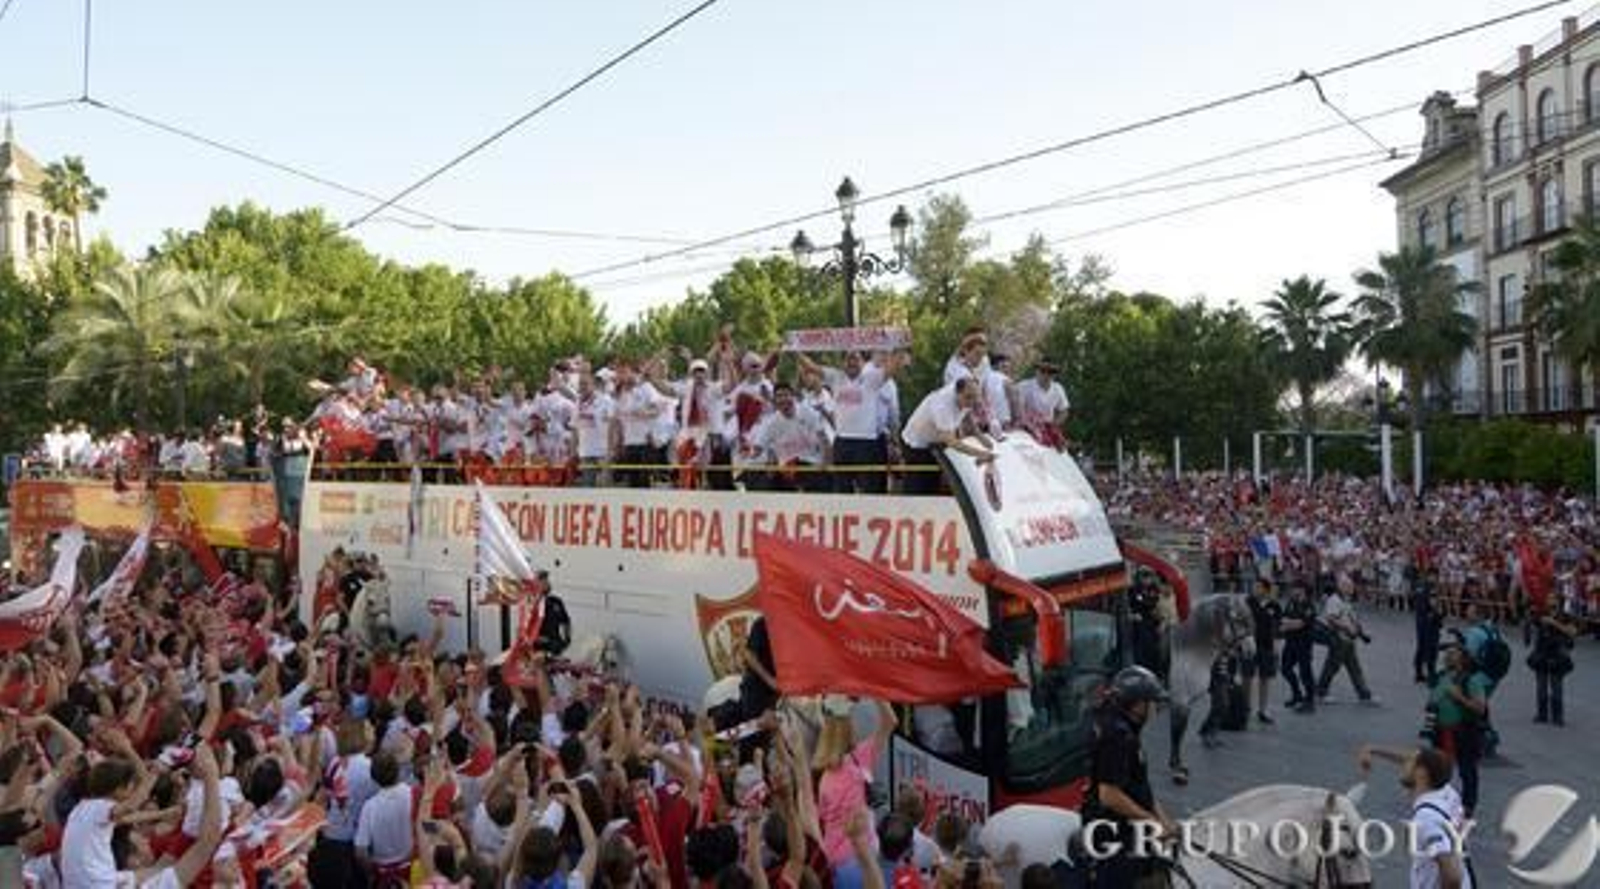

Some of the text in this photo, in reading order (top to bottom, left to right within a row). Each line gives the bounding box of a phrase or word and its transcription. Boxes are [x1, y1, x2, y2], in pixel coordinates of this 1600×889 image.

[553, 504, 611, 548] UEFA
[622, 505, 725, 557] EUROPA
[867, 517, 960, 576] 2014
